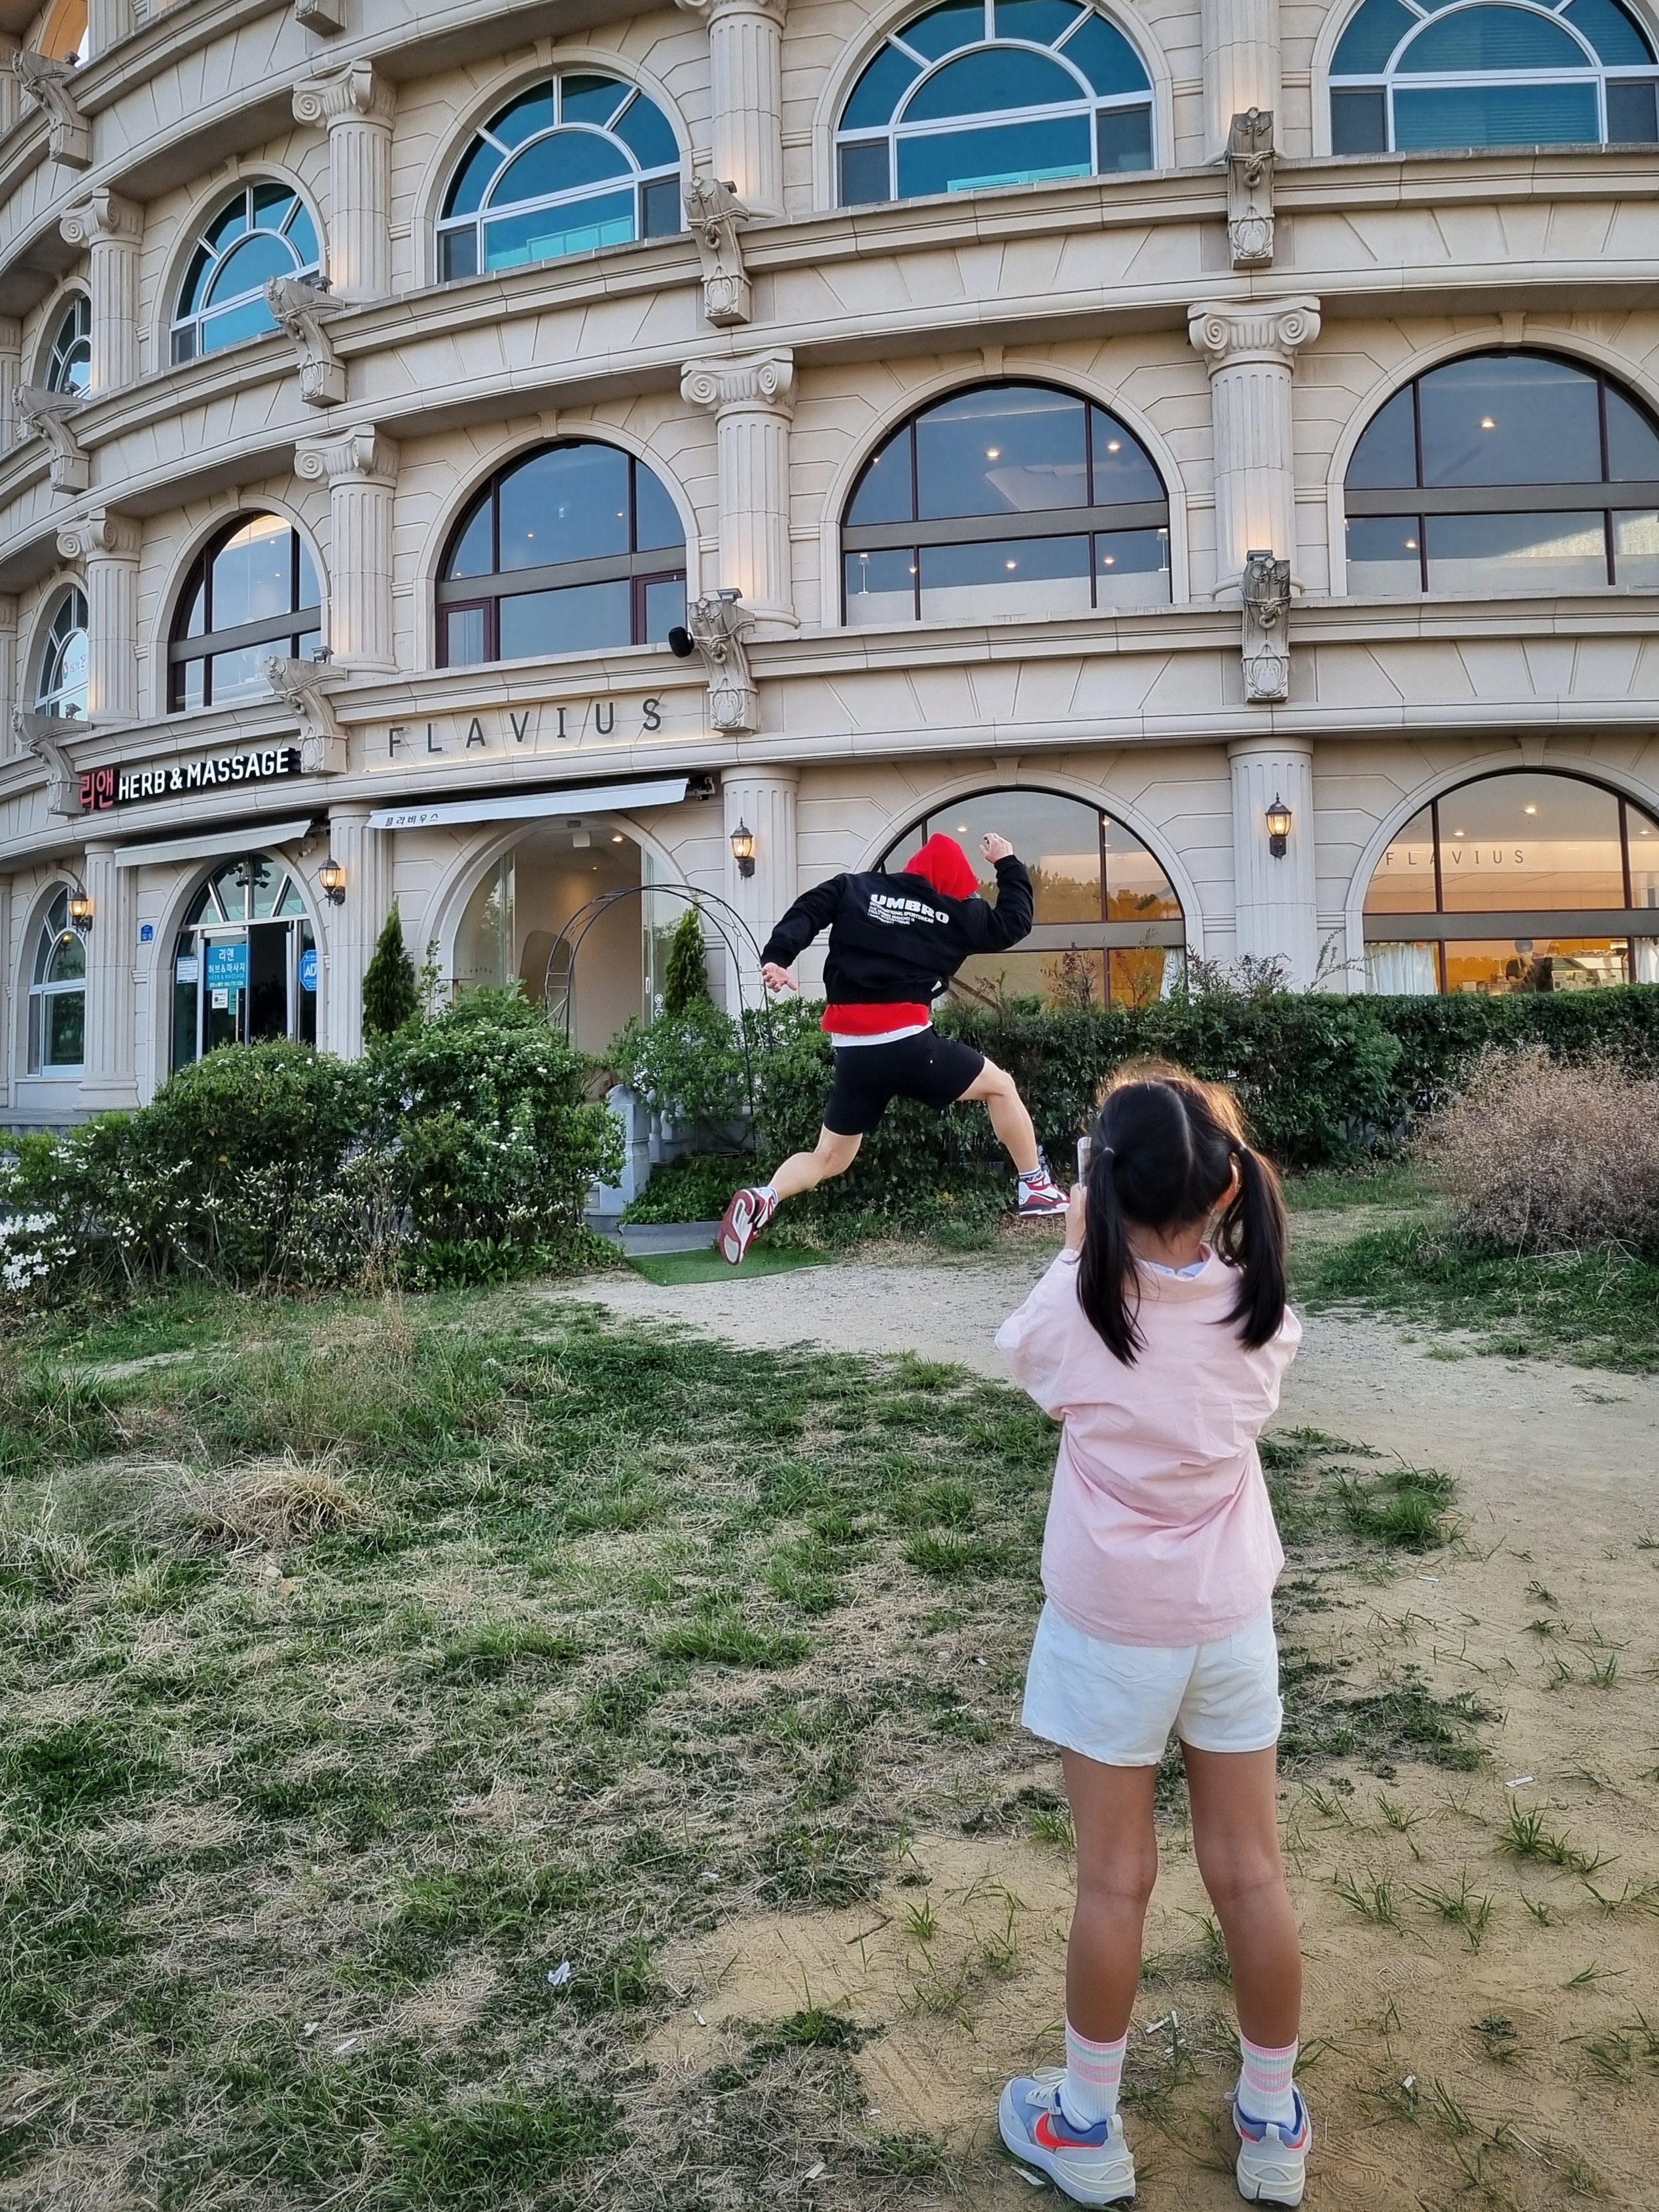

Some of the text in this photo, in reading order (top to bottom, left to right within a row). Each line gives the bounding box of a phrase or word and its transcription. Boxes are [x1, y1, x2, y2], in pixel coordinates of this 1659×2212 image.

[389, 698, 662, 758] FLAVIUS
[79, 769, 114, 810] 리앤
[118, 747, 290, 801] HERB & MASSAGE
[385, 813, 438, 826] 플라비우스
[870, 894, 950, 924] UMBRO
[219, 948, 234, 962] 리앤
